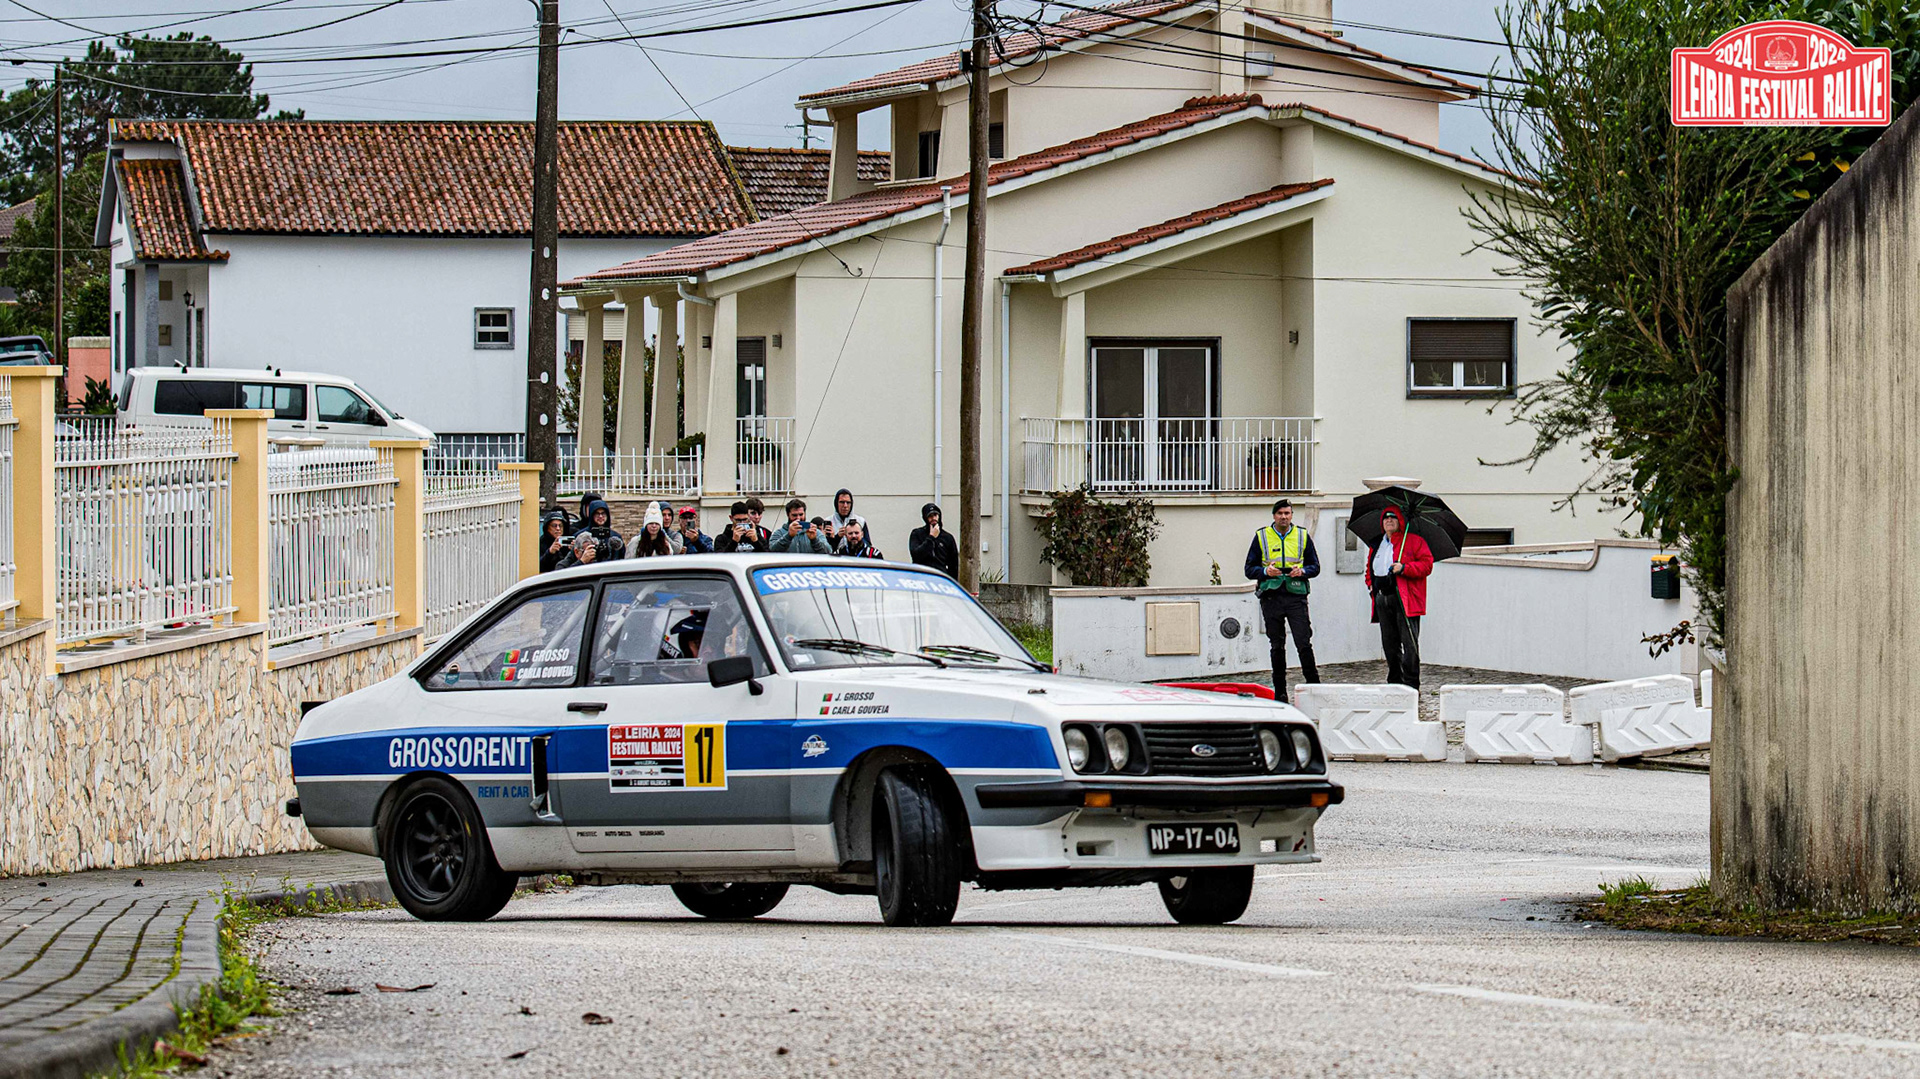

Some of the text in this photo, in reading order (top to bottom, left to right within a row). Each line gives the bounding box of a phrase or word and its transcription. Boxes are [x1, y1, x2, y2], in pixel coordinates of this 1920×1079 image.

[762, 571, 888, 591] GROSSORENT
[898, 578, 930, 591] RENT
[520, 648, 570, 663] J. GROSSO
[517, 665, 574, 680] CARLA GOUVEIA
[835, 692, 875, 701] J. GROSSO
[832, 705, 889, 715] CARLA GOUVEIA
[625, 727, 681, 739] LEIRIA 2024
[388, 736, 531, 768] GROSSORENT
[612, 741, 682, 755] FESTIVAL RALLYE
[694, 727, 714, 784] 17
[478, 786, 530, 798] RENT A CAR
[1151, 826, 1239, 850] NP-17-04
